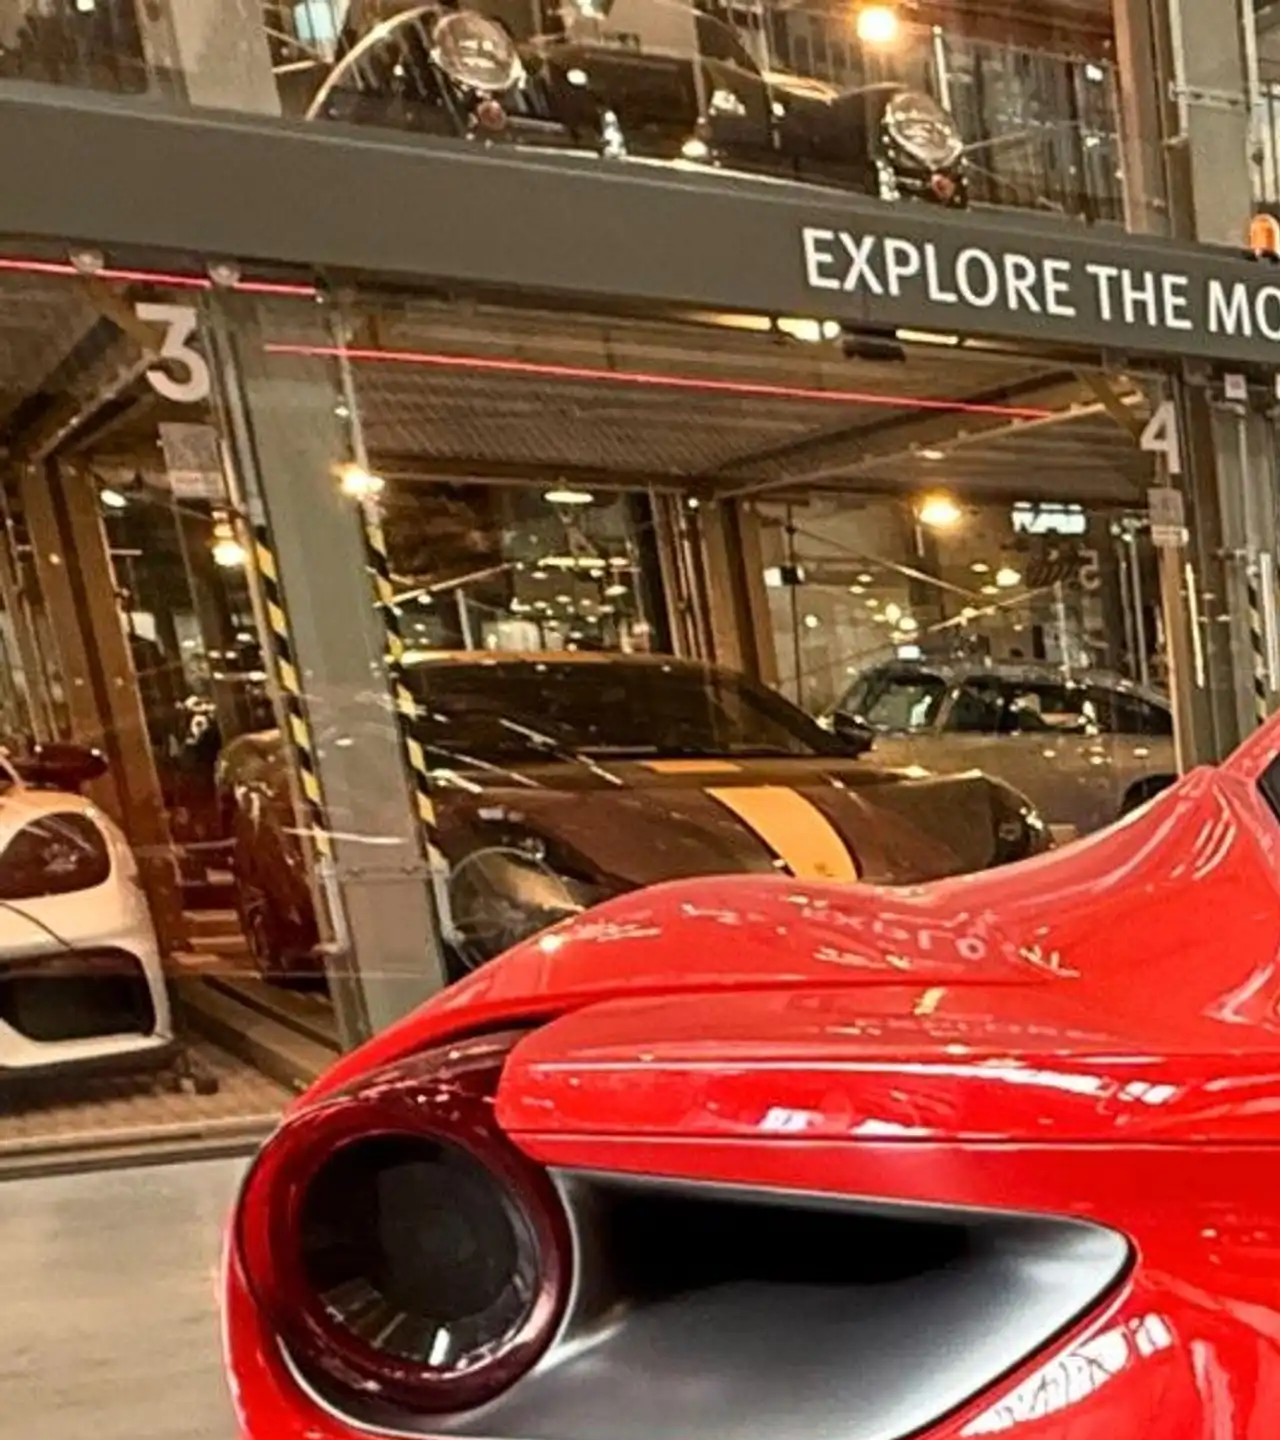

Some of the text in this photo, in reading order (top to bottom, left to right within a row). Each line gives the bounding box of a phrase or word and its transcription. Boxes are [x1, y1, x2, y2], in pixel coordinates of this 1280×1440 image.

[802, 227, 1077, 318] EXPLORE
[1085, 264, 1193, 330] THE
[135, 302, 210, 402] 3
[1139, 400, 1182, 474] 4
